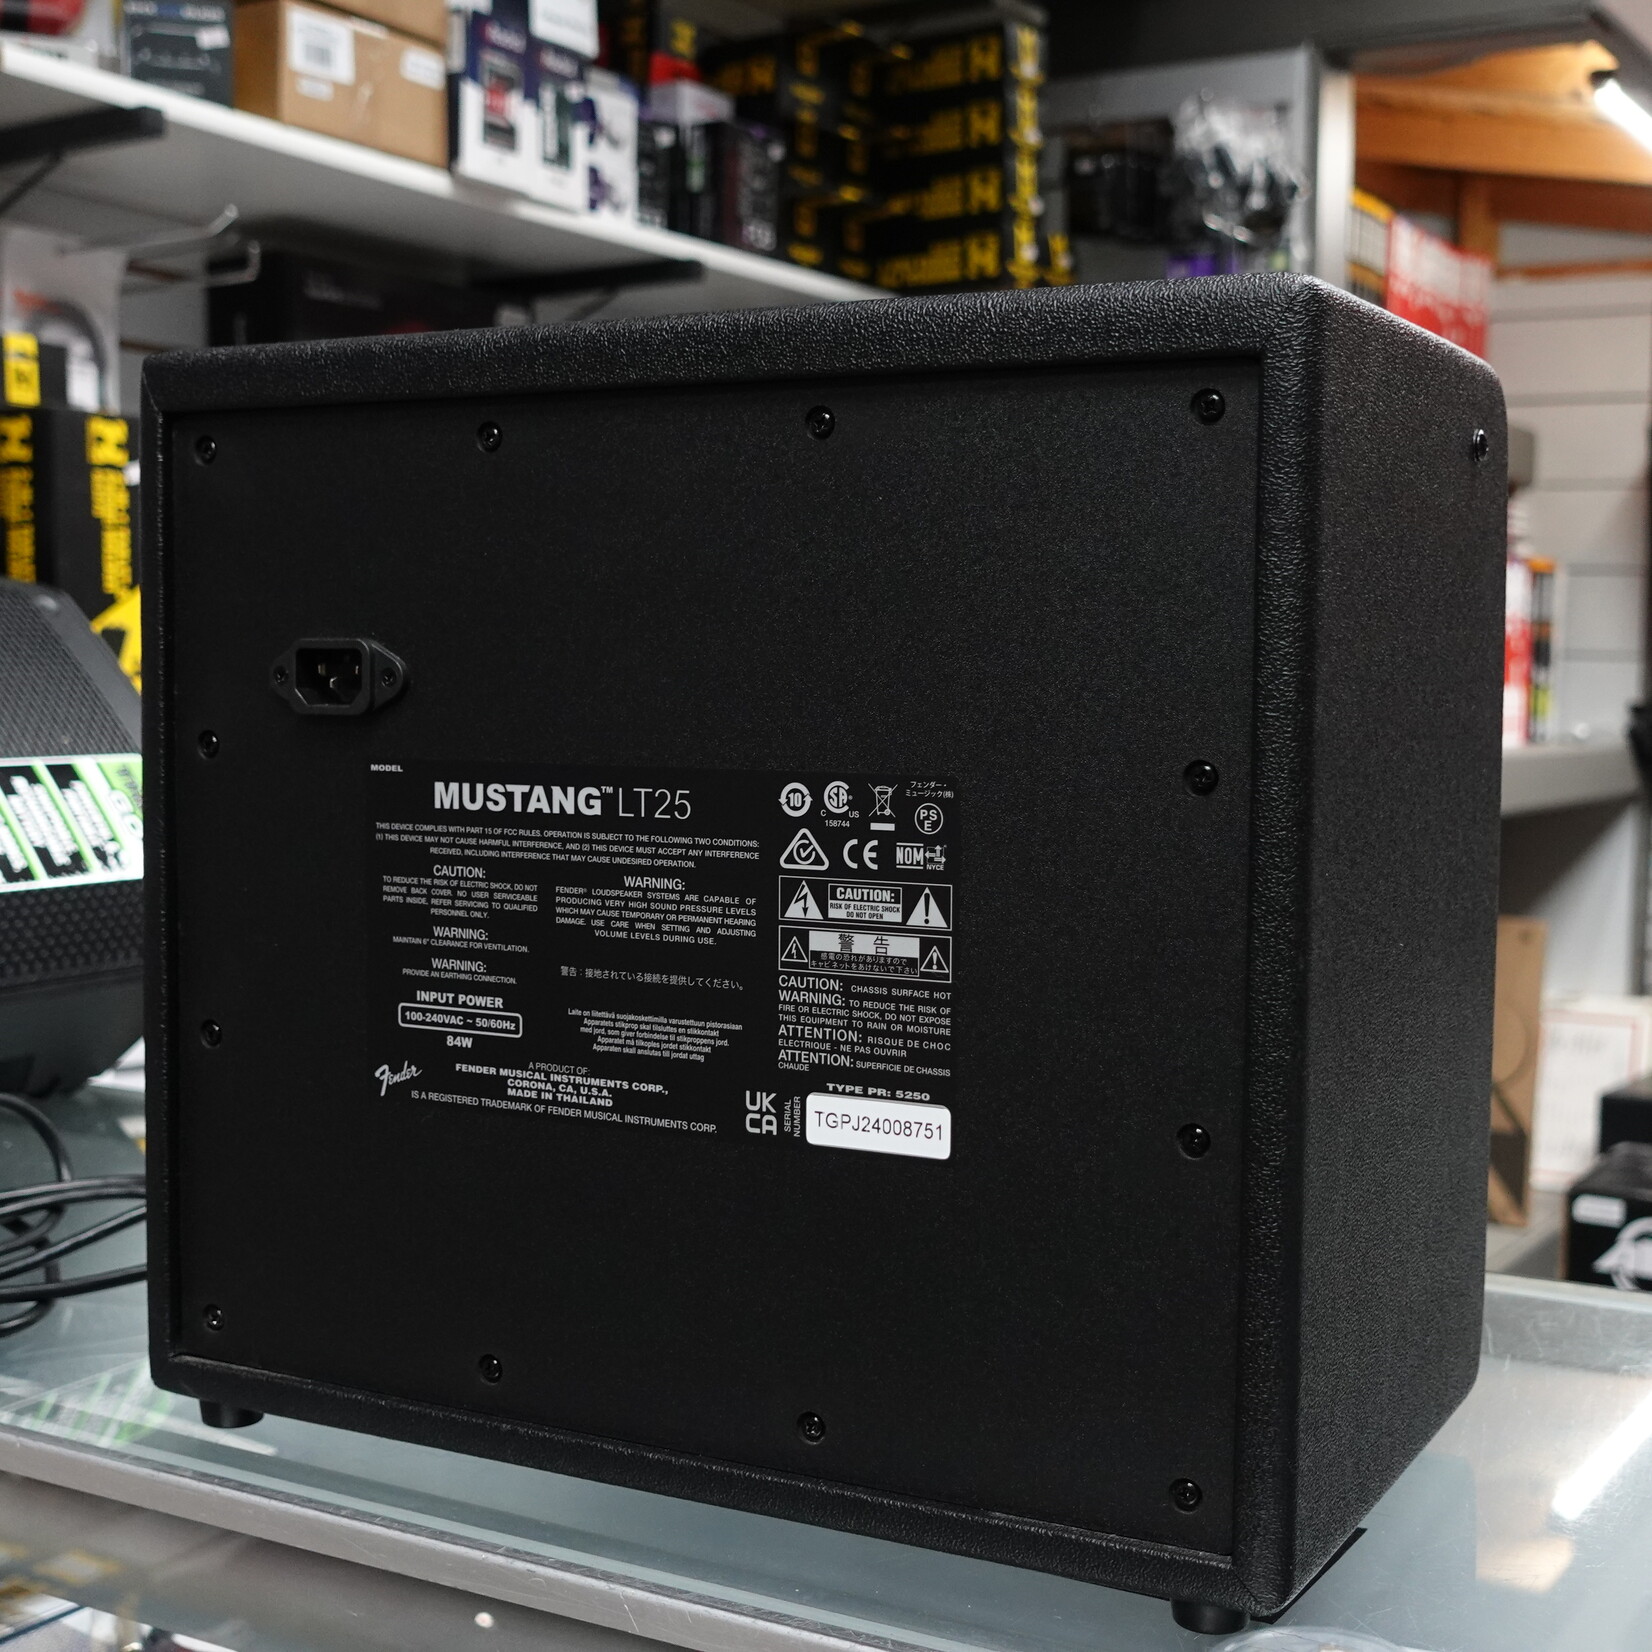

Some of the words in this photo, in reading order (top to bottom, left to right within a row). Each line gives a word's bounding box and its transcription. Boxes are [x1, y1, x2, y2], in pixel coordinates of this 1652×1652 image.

[371, 764, 403, 772] MODEL
[618, 788, 692, 819] LT25
[788, 792, 802, 807] 10
[849, 810, 859, 818] US
[376, 822, 390, 830] THIS
[391, 823, 414, 831] DEVICE
[414, 824, 448, 833] COMPLIES
[448, 826, 465, 834] WITH
[466, 826, 483, 835] PART
[504, 828, 517, 836] FCC
[518, 829, 542, 837] RULES.
[543, 830, 582, 839] OPERATION
[591, 832, 623, 841] SUBJECT
[650, 835, 693, 844] FOLLOWING
[712, 838, 759, 848] CONDITIONS:
[843, 839, 878, 870] CE
[896, 846, 924, 865] NOM
[433, 865, 486, 878] CAUTION:
[624, 876, 685, 890] WARNING:
[592, 888, 643, 898] LOUDSPEAKER
[647, 892, 680, 901] SYSTEMS
[703, 895, 740, 904] CAPABLE
[836, 887, 895, 902] CAUTION:
[555, 897, 602, 906] PRODUCING
[604, 900, 625, 908] VERY
[628, 901, 647, 909] HIGH
[650, 902, 678, 911] SOUND
[680, 904, 723, 914] PRESSURE
[725, 906, 756, 916] LEVELS
[555, 906, 579, 916] WHICH
[580, 908, 595, 917] MAY
[596, 909, 620, 918] CAUSE
[621, 911, 665, 921] TEMPORARY
[666, 914, 677, 922] OR
[678, 914, 723, 925] PERMANENT
[724, 917, 756, 927] HEARING
[433, 926, 488, 940] WARNING:
[556, 917, 586, 926] DAMAGE.
[591, 919, 604, 928] USE
[611, 920, 629, 929] CARE
[635, 922, 655, 931] WHEN
[662, 924, 690, 933] SETTING
[696, 926, 711, 934] AND
[717, 927, 756, 937] ADJUSTING
[594, 930, 628, 939] VOLUME
[630, 932, 660, 941] LEVELS
[662, 934, 695, 944] DURING
[697, 937, 716, 945] USE.
[431, 958, 486, 972] WARNING:
[779, 975, 844, 991] CAUTION:
[850, 985, 888, 996] CHASSIS
[891, 988, 930, 998] SURFACE
[933, 991, 951, 1000] HOT
[416, 990, 455, 1004] INPUT
[458, 994, 503, 1008] POWER
[779, 989, 846, 1006] WARNING:
[863, 1001, 896, 1010] REDUCE
[898, 1004, 915, 1012] THE
[917, 1005, 937, 1014] RISK
[939, 1007, 951, 1015] OF
[405, 1011, 464, 1026] 100-240VAC
[475, 1016, 516, 1030] 50/60Hz
[778, 1005, 795, 1013] FIRE
[798, 1006, 810, 1014] OR
[812, 1007, 850, 1017] ELECTRIC
[852, 1010, 882, 1020] SHOCK,
[885, 1013, 897, 1021] DO
[899, 1014, 916, 1022] NOT
[919, 1015, 951, 1025] EXPOSE
[778, 1014, 797, 1023] THIS
[800, 1016, 848, 1027] EQUIPMENT
[852, 1020, 863, 1028] TO
[867, 1021, 887, 1030] RAIN
[890, 1023, 903, 1032] OR
[906, 1024, 951, 1036] MOISTURE
[446, 1035, 472, 1048] 84W
[778, 1024, 863, 1043] ATTENTION:
[867, 1036, 904, 1046] RISQUE
[907, 1039, 920, 1048] DE
[922, 1041, 951, 1051] CHOC
[778, 1039, 831, 1051] ELECTRIQUE
[840, 1044, 852, 1052] NE
[854, 1046, 871, 1054] PAS
[873, 1047, 907, 1057] OUVRIR
[528, 1062, 534, 1070] A
[535, 1063, 575, 1074] PRODUCT
[576, 1066, 590, 1076] OF:
[778, 1049, 854, 1067] ATTENTION:
[856, 1061, 901, 1072] SUPERFICIE
[904, 1065, 914, 1073] DE
[916, 1066, 950, 1076] CHASSIS
[778, 1062, 810, 1071] CHAUDE
[374, 1060, 422, 1096] Fender
[455, 1063, 496, 1075] FENDER
[499, 1068, 547, 1081] MUSICAL
[550, 1073, 629, 1090] INSTRUMENTS
[507, 1079, 556, 1091] CORONA,
[558, 1084, 577, 1093] CA,
[580, 1086, 612, 1097] U.S.A.
[507, 1088, 538, 1099] MADE
[541, 1091, 553, 1100] IN
[556, 1093, 613, 1107] THAILAND
[826, 1083, 863, 1095] TYPE
[868, 1086, 891, 1098] PR:
[895, 1088, 930, 1101] 5250
[746, 1090, 777, 1113] UK
[411, 1090, 419, 1099] IS
[420, 1092, 427, 1100] A
[428, 1092, 479, 1106] REGISTERED
[480, 1098, 532, 1112] TRADEMARK
[534, 1104, 546, 1113] OF
[548, 1106, 582, 1118] FENDER
[584, 1110, 623, 1122] MUSICAL
[624, 1114, 688, 1130] INSTRUMENTS
[690, 1122, 717, 1133] CORP.
[746, 1114, 777, 1135] CA
[814, 1111, 942, 1141] TGPJ24008751
